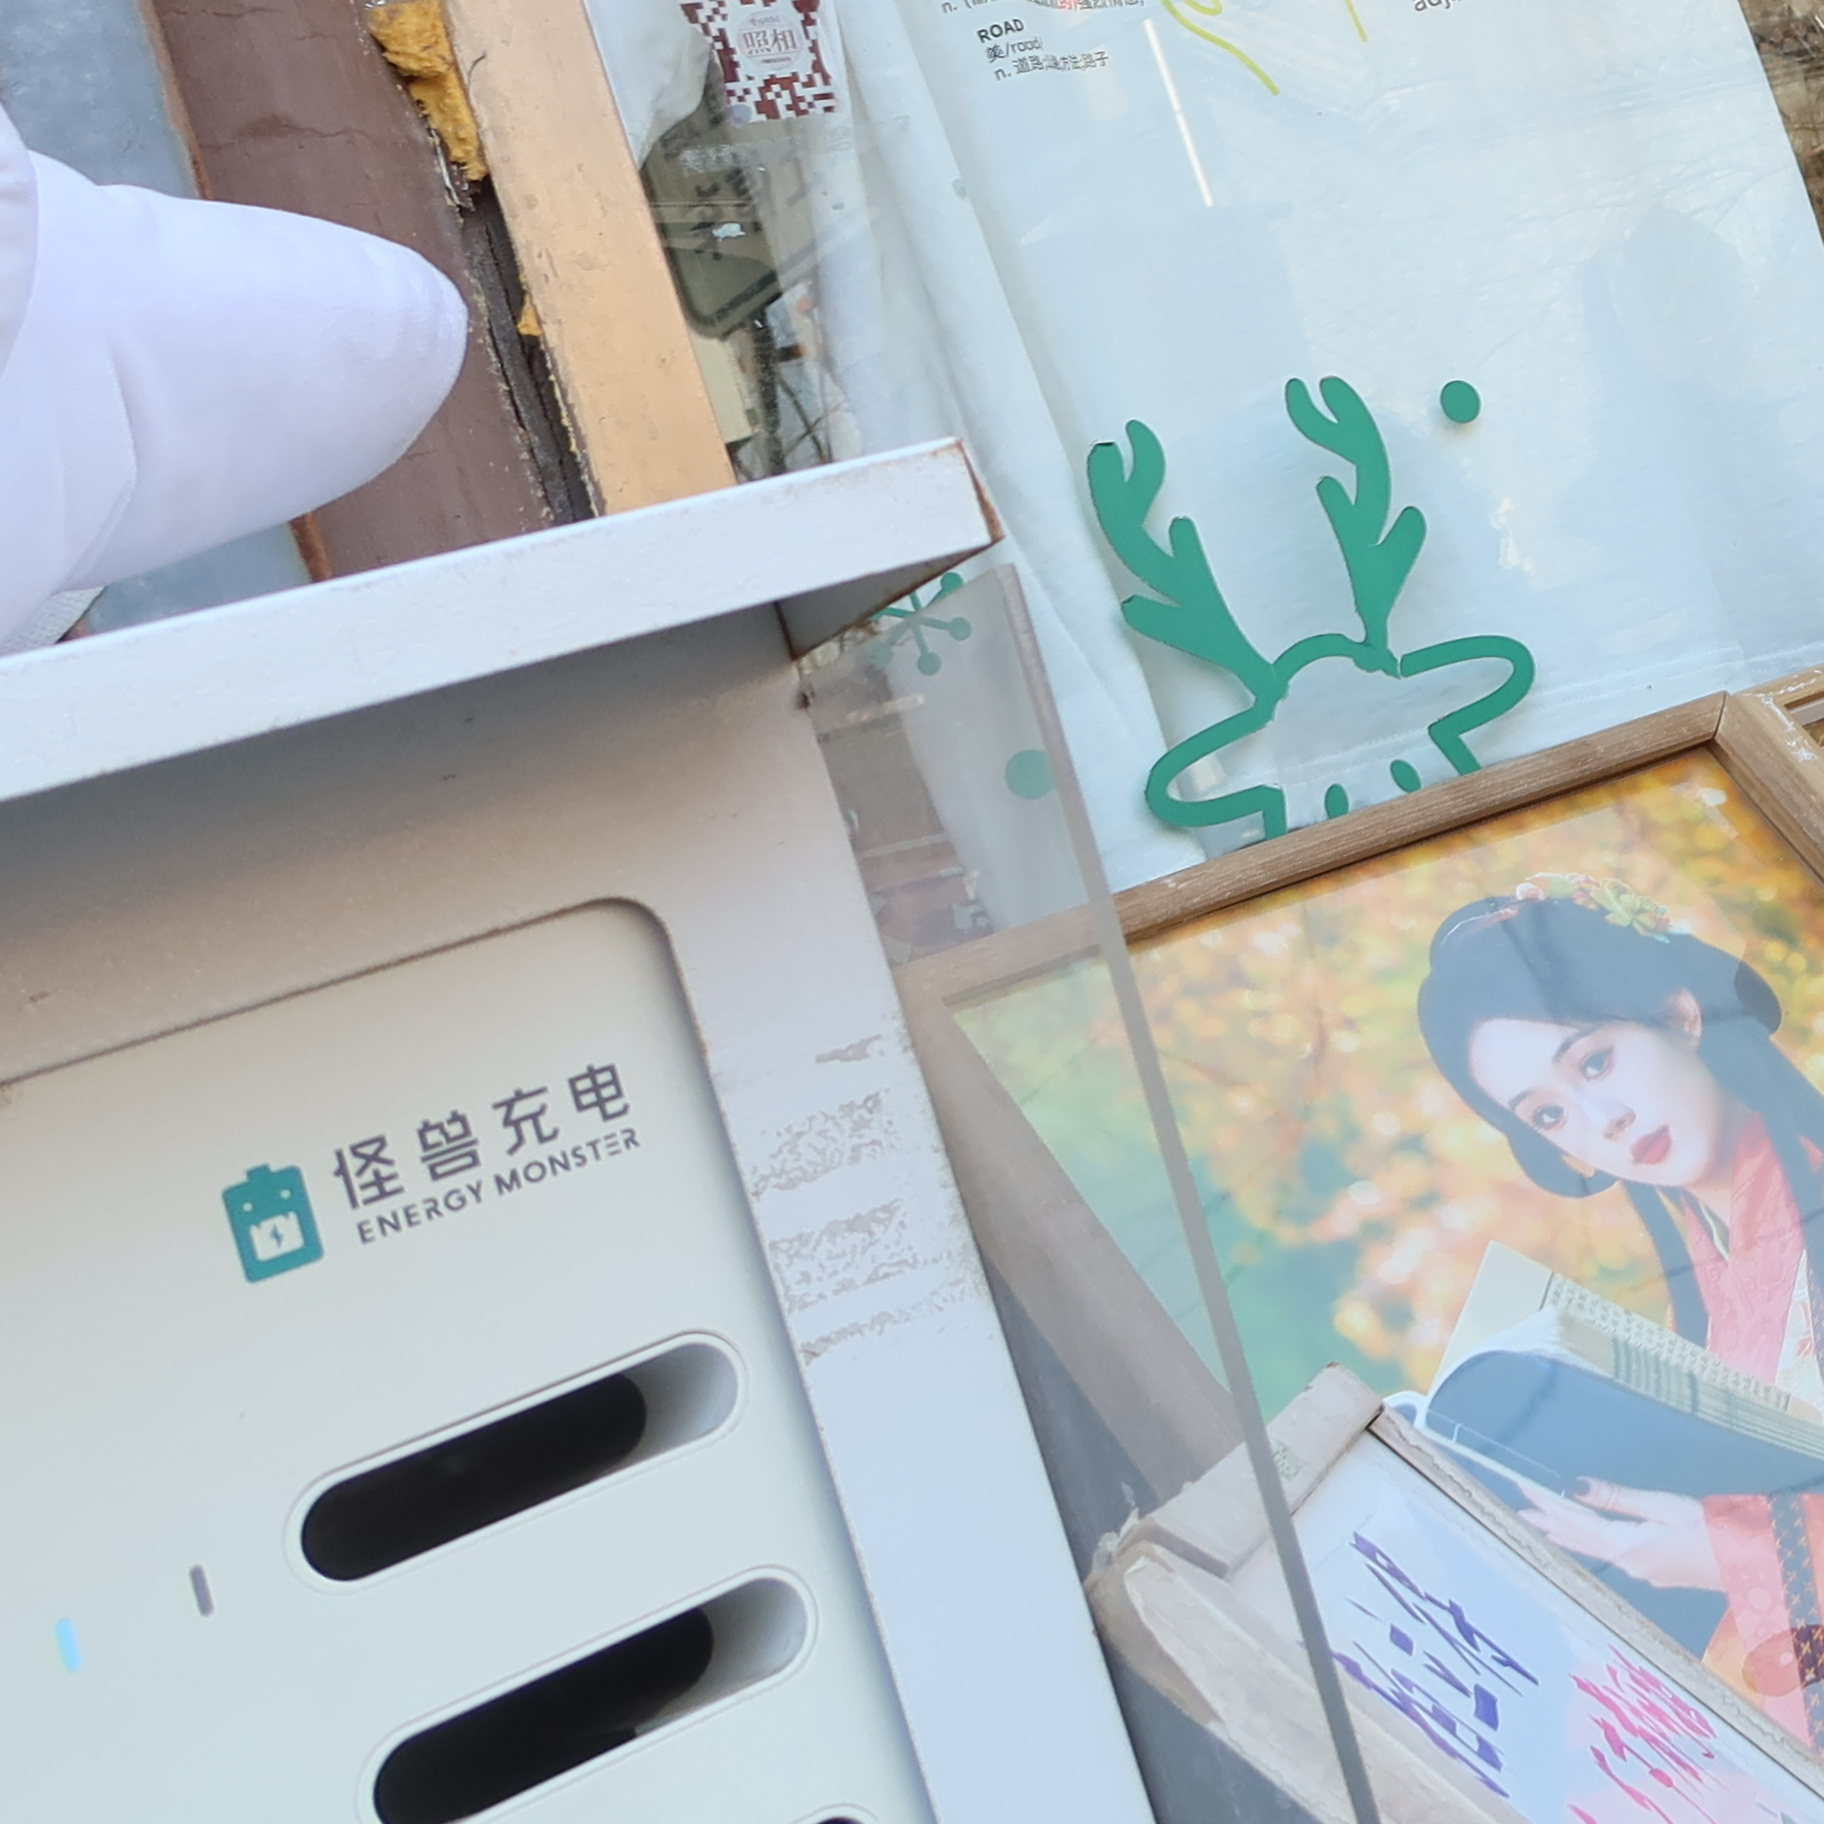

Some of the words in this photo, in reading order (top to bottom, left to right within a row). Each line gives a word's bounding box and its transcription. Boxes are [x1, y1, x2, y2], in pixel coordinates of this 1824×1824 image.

[977, 18, 1025, 43] ROAD
[333, 1062, 632, 1210] 怪兽充电
[355, 1180, 485, 1244] ENERGY
[495, 1126, 641, 1196] MONSTER
